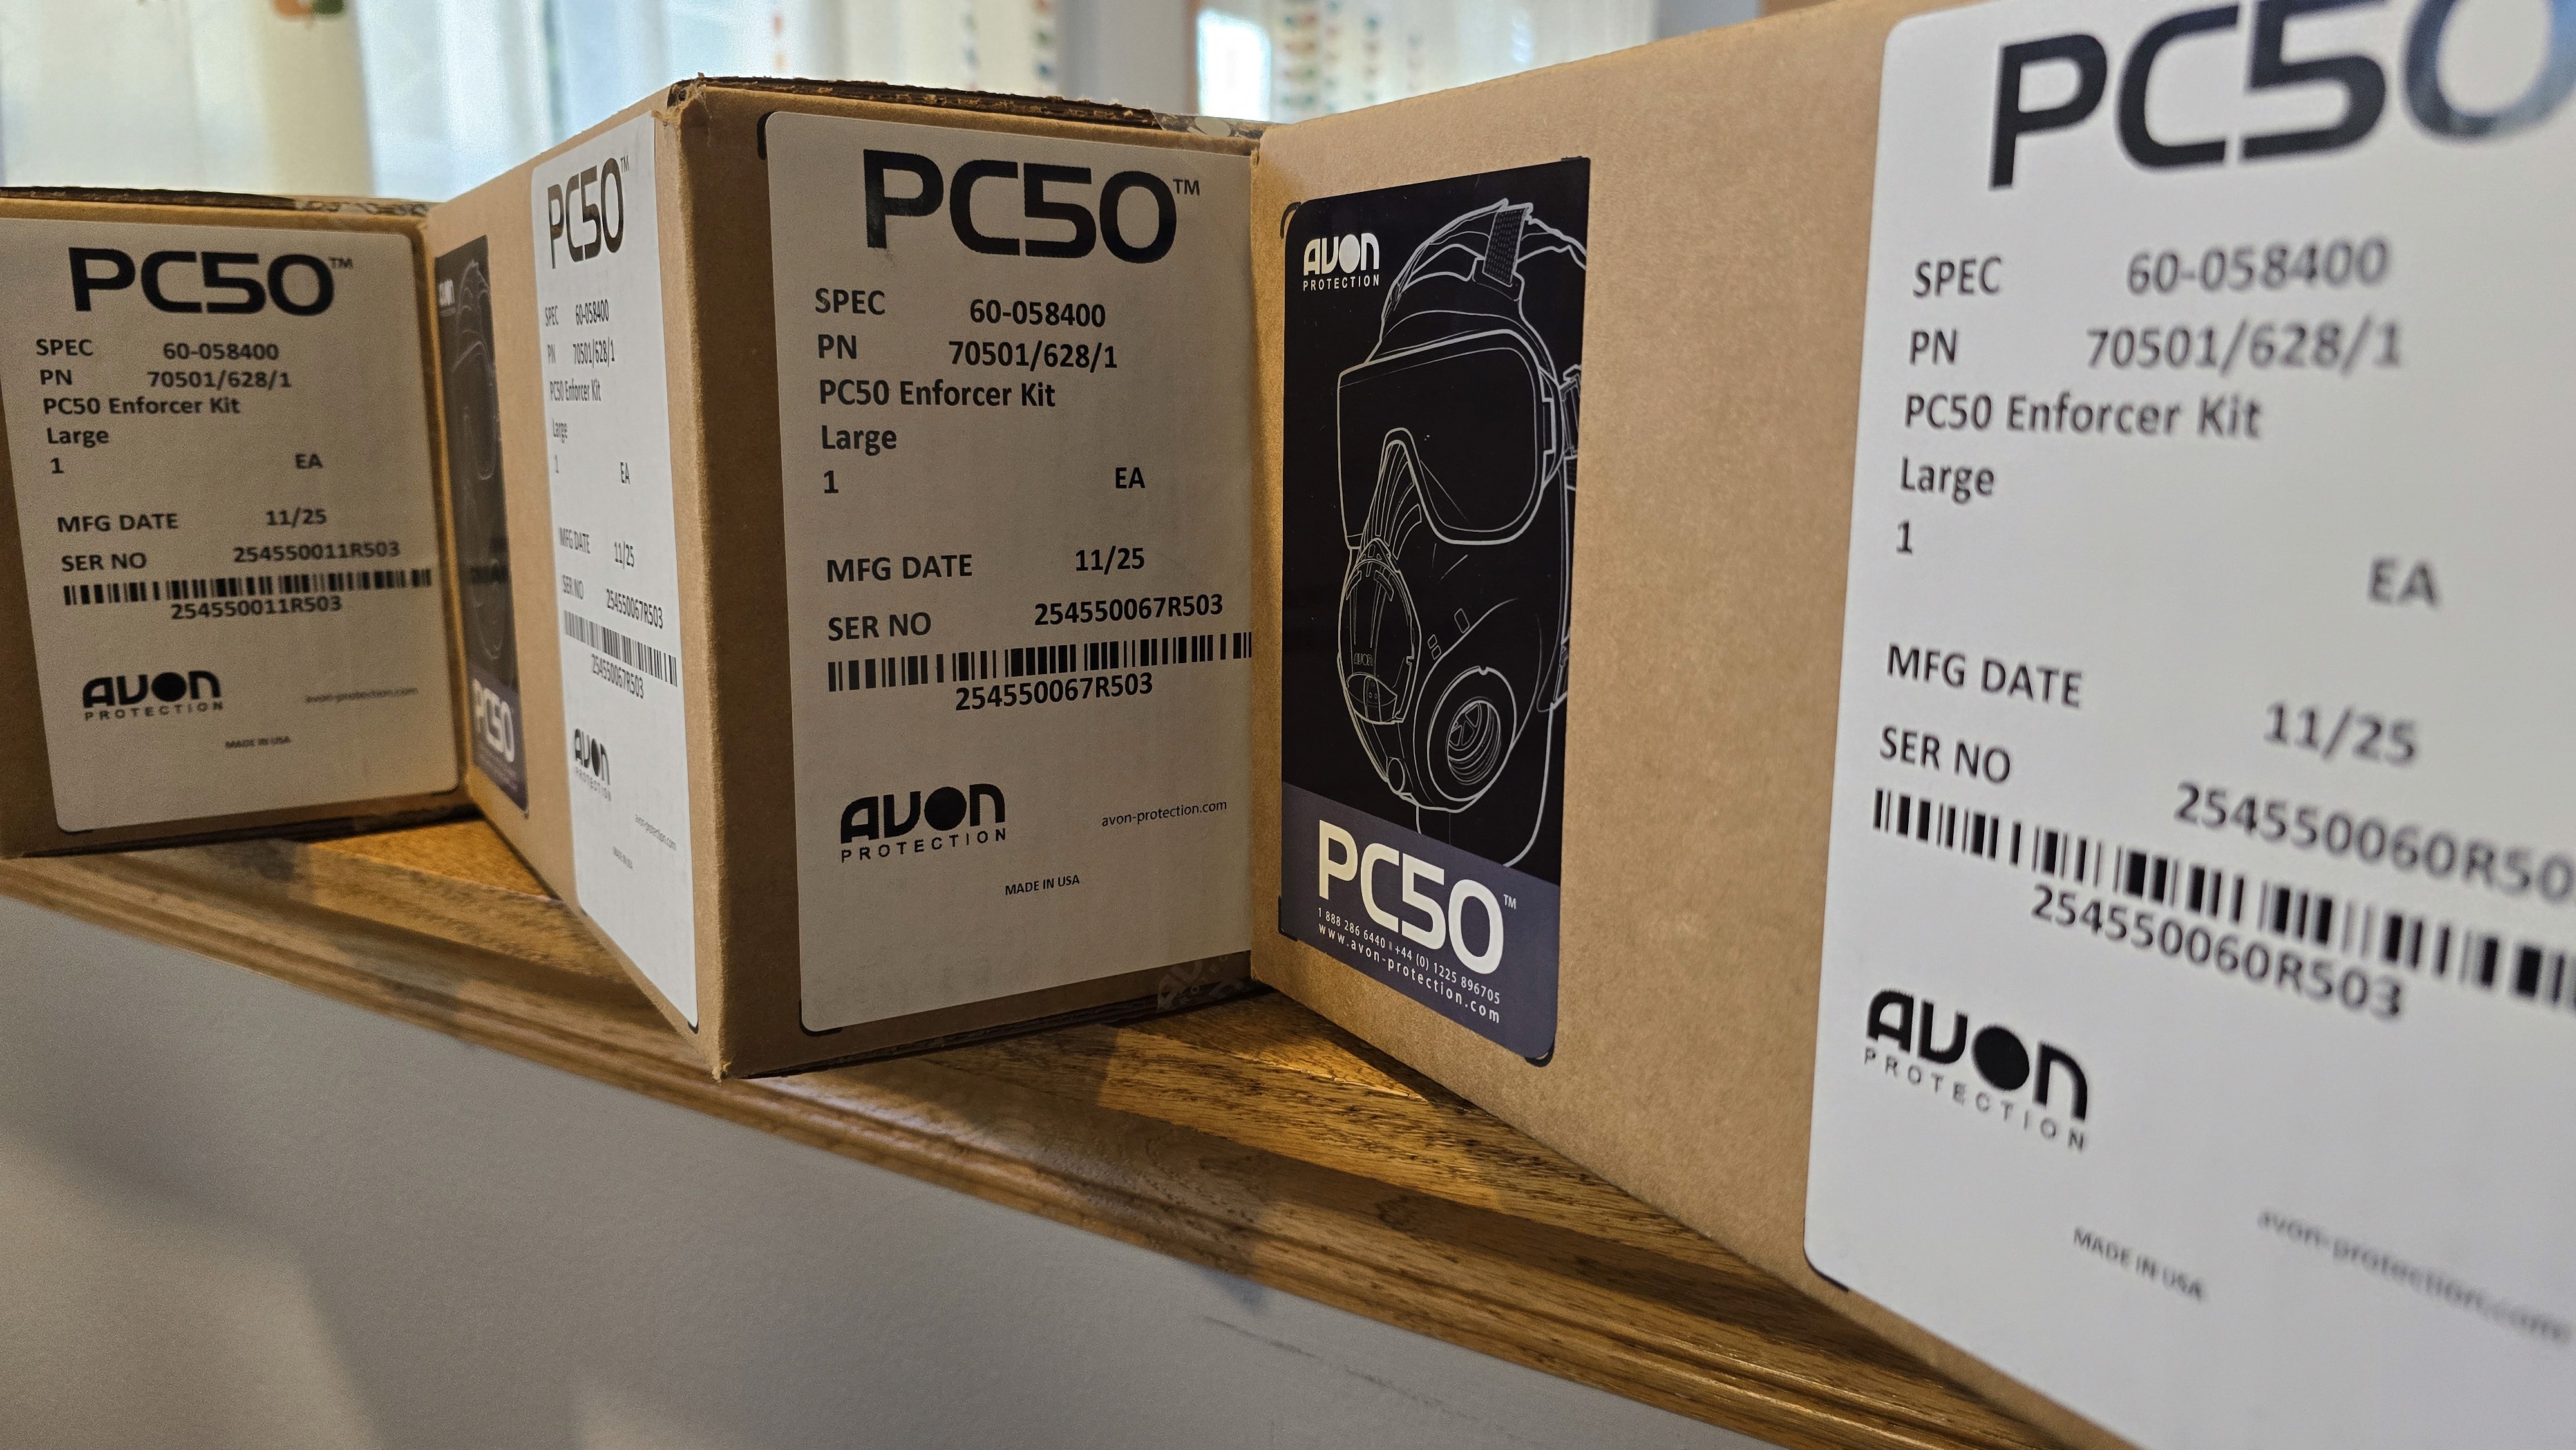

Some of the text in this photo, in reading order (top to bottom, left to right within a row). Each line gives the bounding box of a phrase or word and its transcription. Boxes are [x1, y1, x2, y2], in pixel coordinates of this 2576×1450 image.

[1987, 0, 2576, 191] PC50
[1303, 274, 1379, 292] PROTECTION
[1913, 238, 2391, 298] SPEC 60-058400
[544, 299, 609, 327] SPEC 60-058400
[815, 287, 1106, 328] SPEC 60-058400
[35, 338, 279, 361] SPEC 60-058400
[546, 337, 616, 366] PN 70501/628/1
[817, 334, 1117, 373] PN 70501/628/1
[1910, 316, 2400, 375] PN 70501/628/1
[39, 369, 292, 391] PN 70501/628/1
[565, 378, 590, 402] Enforcer
[591, 378, 601, 402] Kit
[819, 378, 1056, 408] PC50 Enforcer Kit
[43, 395, 241, 415] PC50 Enforcer Kit
[1906, 391, 2261, 438] PC50 Enforcer Kit
[46, 427, 109, 449] Large
[552, 420, 568, 444] Large
[821, 424, 897, 457] Large
[50, 453, 323, 475] 1 EA
[620, 462, 630, 484] EA
[823, 467, 1146, 494] 1 EA
[1901, 457, 1995, 505] Large
[57, 507, 327, 533] MFG DATE 11/25
[61, 540, 401, 572] SER NO 254550011R503
[574, 532, 591, 554] DATE
[614, 541, 635, 568] 11/25
[827, 545, 1145, 583] MFG DATE 11/25
[1897, 521, 2438, 607] 1 EA
[171, 595, 342, 619] 254550011R503
[606, 587, 663, 630] 254550067R503
[828, 593, 1223, 642] SER NO 254550067R503
[955, 673, 1153, 711] 254550067R503
[1888, 645, 2417, 765] MFG DATE 11/25
[84, 701, 224, 721] PROTECTION
[1880, 726, 1940, 769] SER
[1955, 741, 2011, 784] NO
[1101, 801, 1227, 827] avon-protection.com
[840, 827, 1007, 863] PROTECTION
[1005, 874, 1080, 896] MADE IN USA
[1318, 907, 1501, 1004] 1 888 286 6440 +44 (0) 1225 896705
[2030, 883, 2405, 1020] 254550060R503
[1319, 923, 1501, 1024] www.avon-protection.com
[1864, 1046, 2087, 1153] PROTECTION
[2072, 1225, 2205, 1302] MADE IN USA
